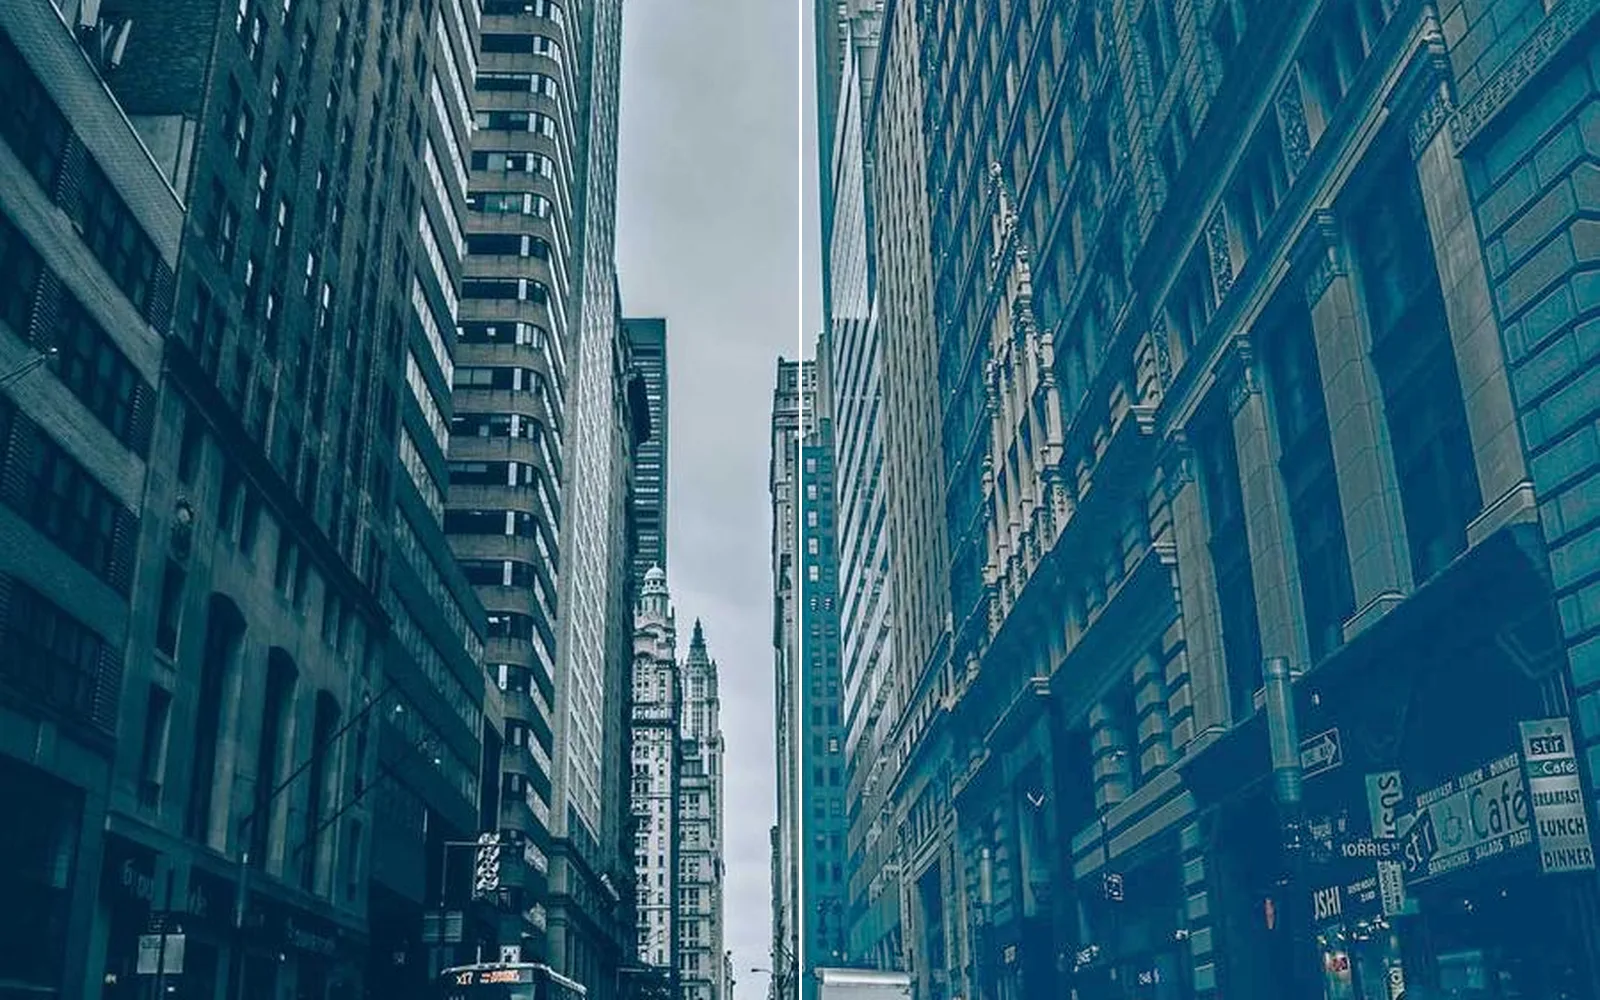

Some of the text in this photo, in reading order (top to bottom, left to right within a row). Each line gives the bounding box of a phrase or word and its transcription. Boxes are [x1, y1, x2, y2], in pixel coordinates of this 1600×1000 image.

[1532, 738, 1563, 754] stir
[1533, 789, 1582, 807] BREAKFAST
[1470, 778, 1529, 839] Café
[1540, 817, 1586, 837] LUNCH
[1544, 848, 1592, 868] DINNER
